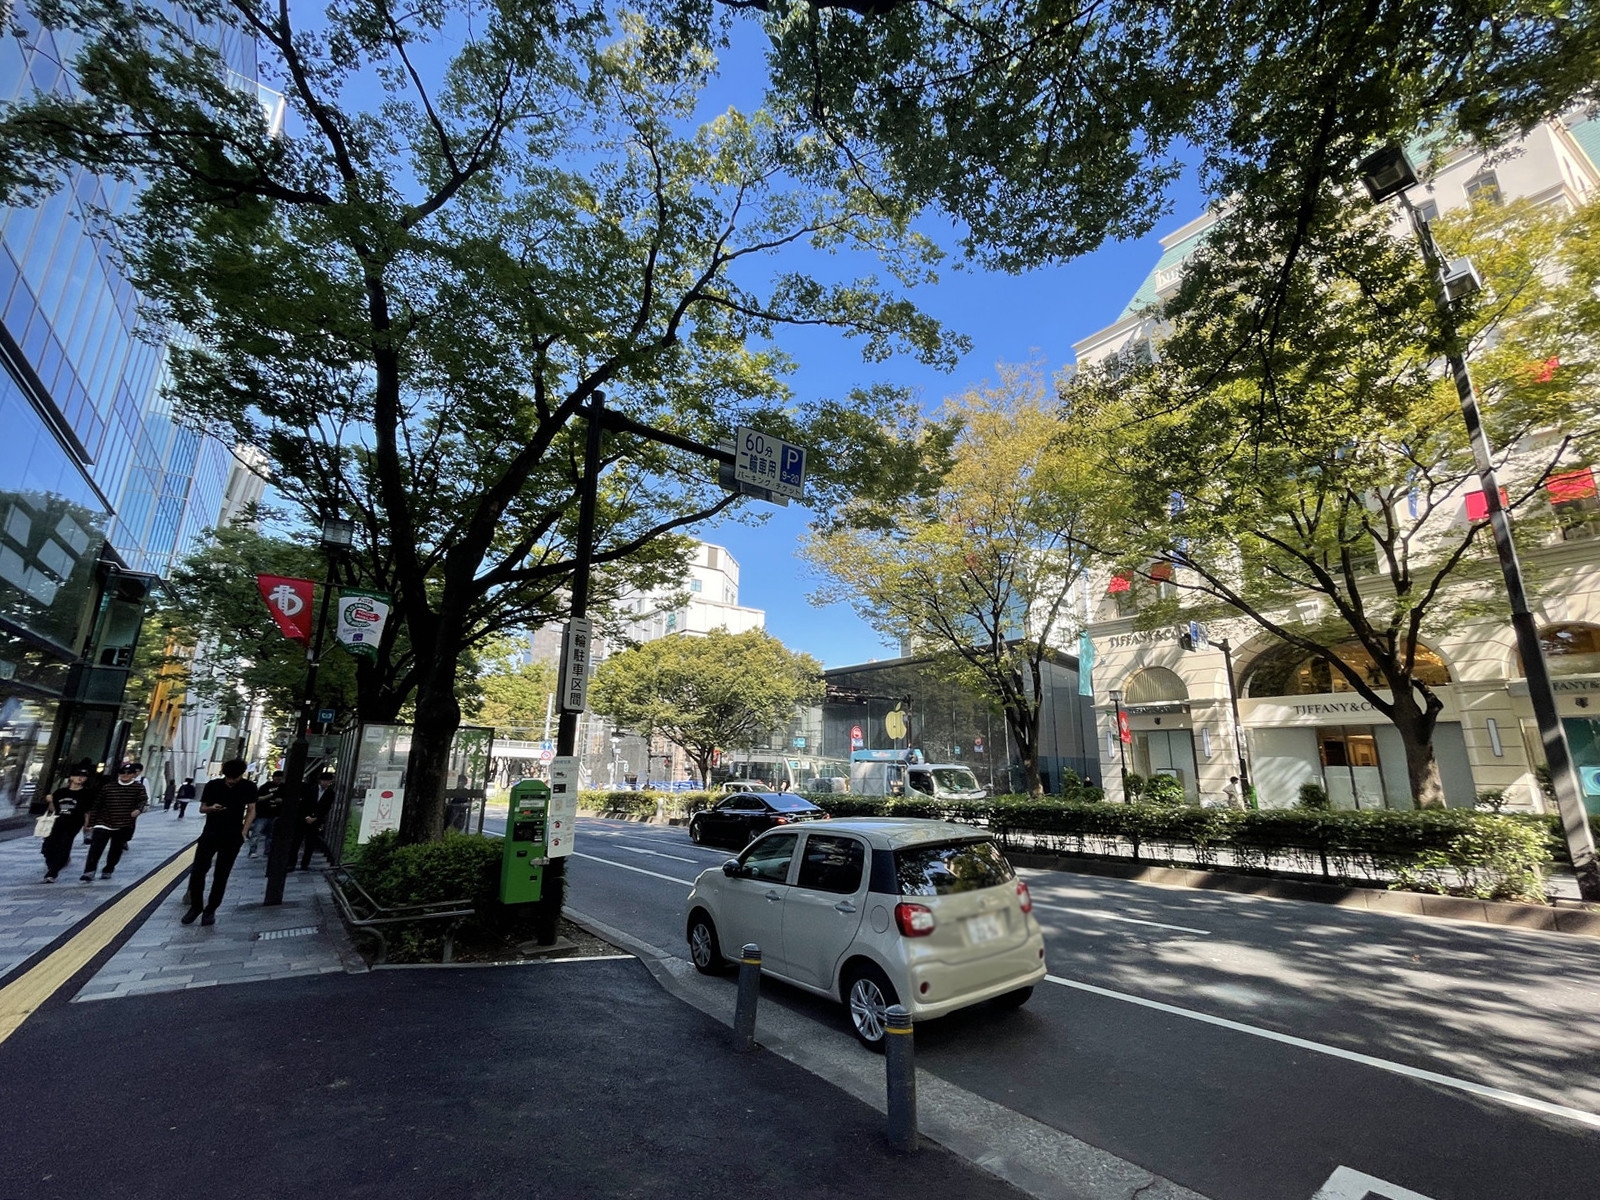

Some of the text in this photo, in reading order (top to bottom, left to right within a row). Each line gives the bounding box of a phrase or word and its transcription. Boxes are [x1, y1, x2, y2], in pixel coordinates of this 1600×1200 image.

[746, 433, 773, 458] 60分
[739, 451, 777, 479] 二輪車用
[787, 449, 799, 470] P
[782, 470, 800, 484] 9-20
[569, 620, 588, 707] 二輪駐車区間
